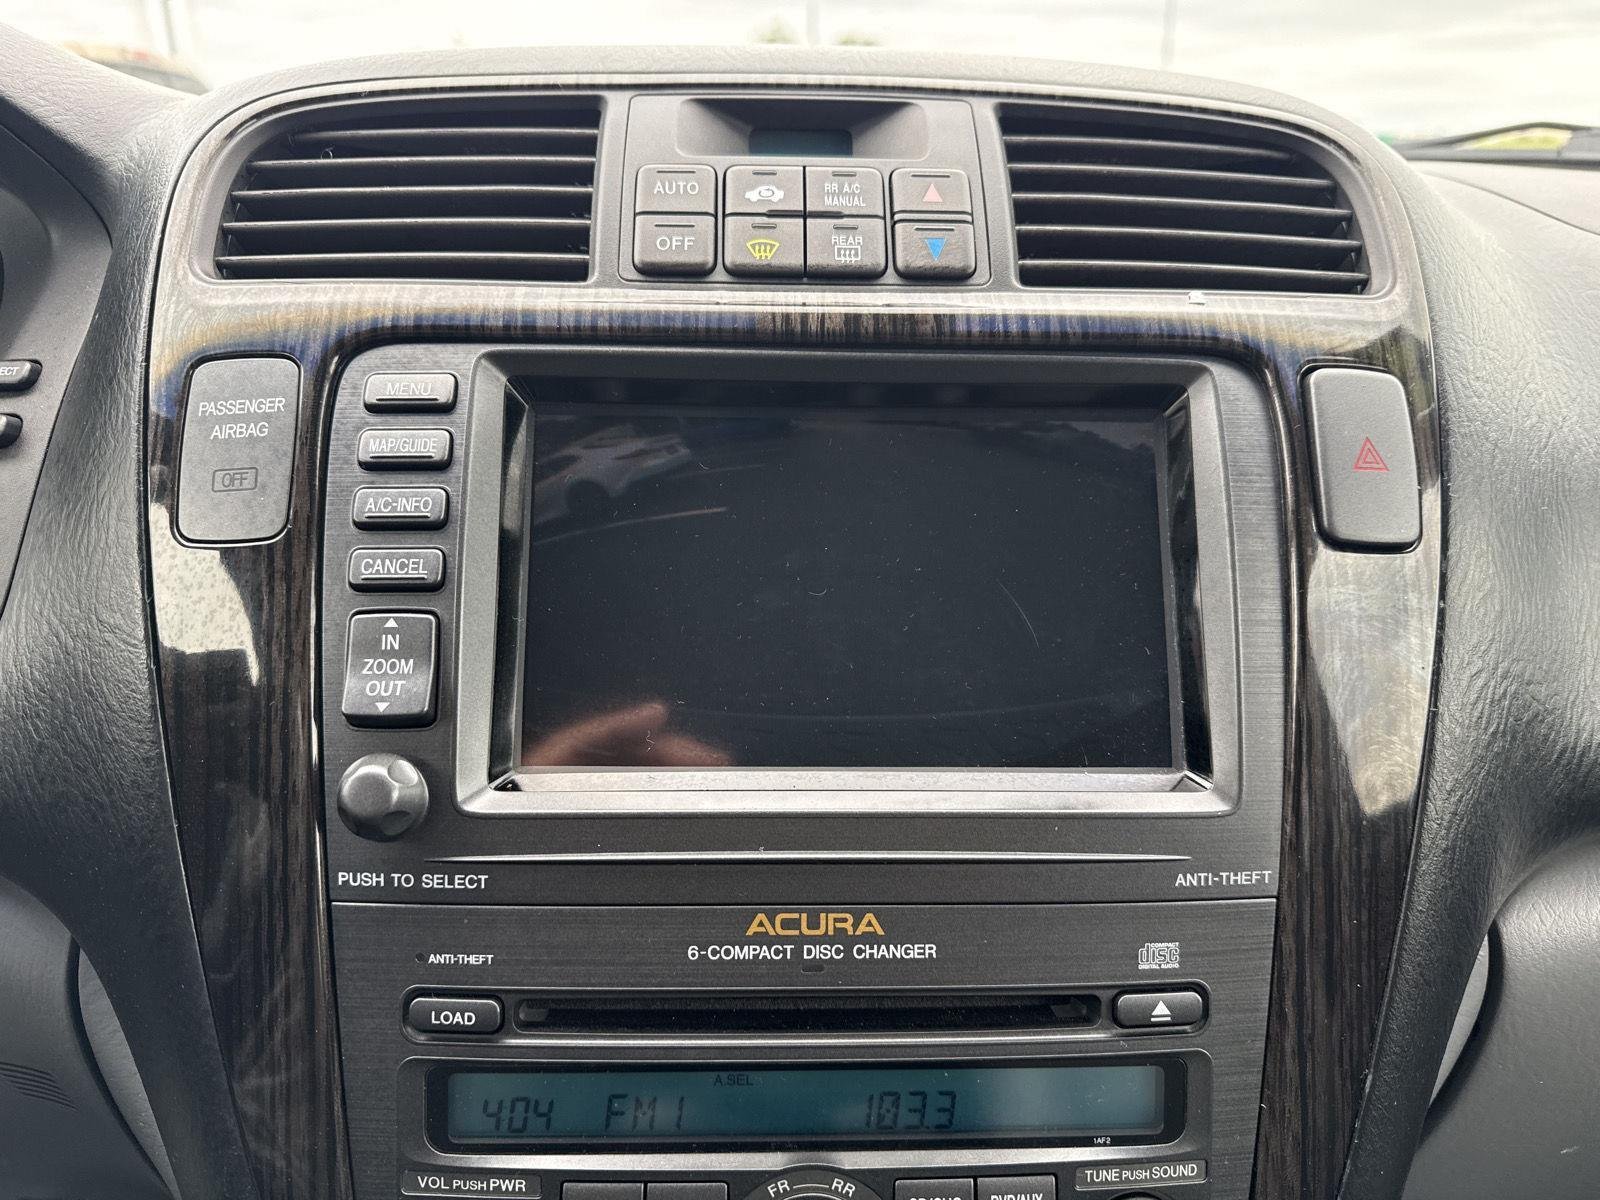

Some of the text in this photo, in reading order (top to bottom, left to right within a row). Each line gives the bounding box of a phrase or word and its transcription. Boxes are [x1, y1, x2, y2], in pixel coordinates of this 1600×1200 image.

[654, 182, 699, 195] AUTO
[824, 183, 861, 193] RR A/C
[824, 196, 866, 206] MANUAL
[656, 237, 695, 250] OFF
[832, 236, 863, 246] REAR
[386, 381, 432, 397] MENU
[198, 397, 286, 416] PASSENGER
[210, 422, 270, 440] AIRBAG
[368, 437, 437, 452] MAP/GUIDE
[222, 472, 249, 487] OFF
[365, 497, 433, 512] A/C-INFO
[360, 558, 428, 574] CANCEL
[381, 635, 400, 650] IN
[362, 659, 414, 674] ZOOM
[366, 681, 406, 696] OUT
[338, 873, 488, 889] PUSH TO SELECT
[1175, 871, 1272, 887] ANTI-THEFT
[745, 911, 885, 937] ACURA
[428, 954, 493, 964] ANTI-THEFT
[687, 944, 937, 960] 6-COMPACT DISC CHANGER
[431, 1011, 476, 1025] LOAD
[713, 1073, 754, 1086] A.SEL
[1085, 1164, 1198, 1182] TUNE PUSH SOUND
[417, 1177, 526, 1192] VOL PUSH PWR
[767, 1180, 791, 1197] FR
[831, 1178, 856, 1197] RR
